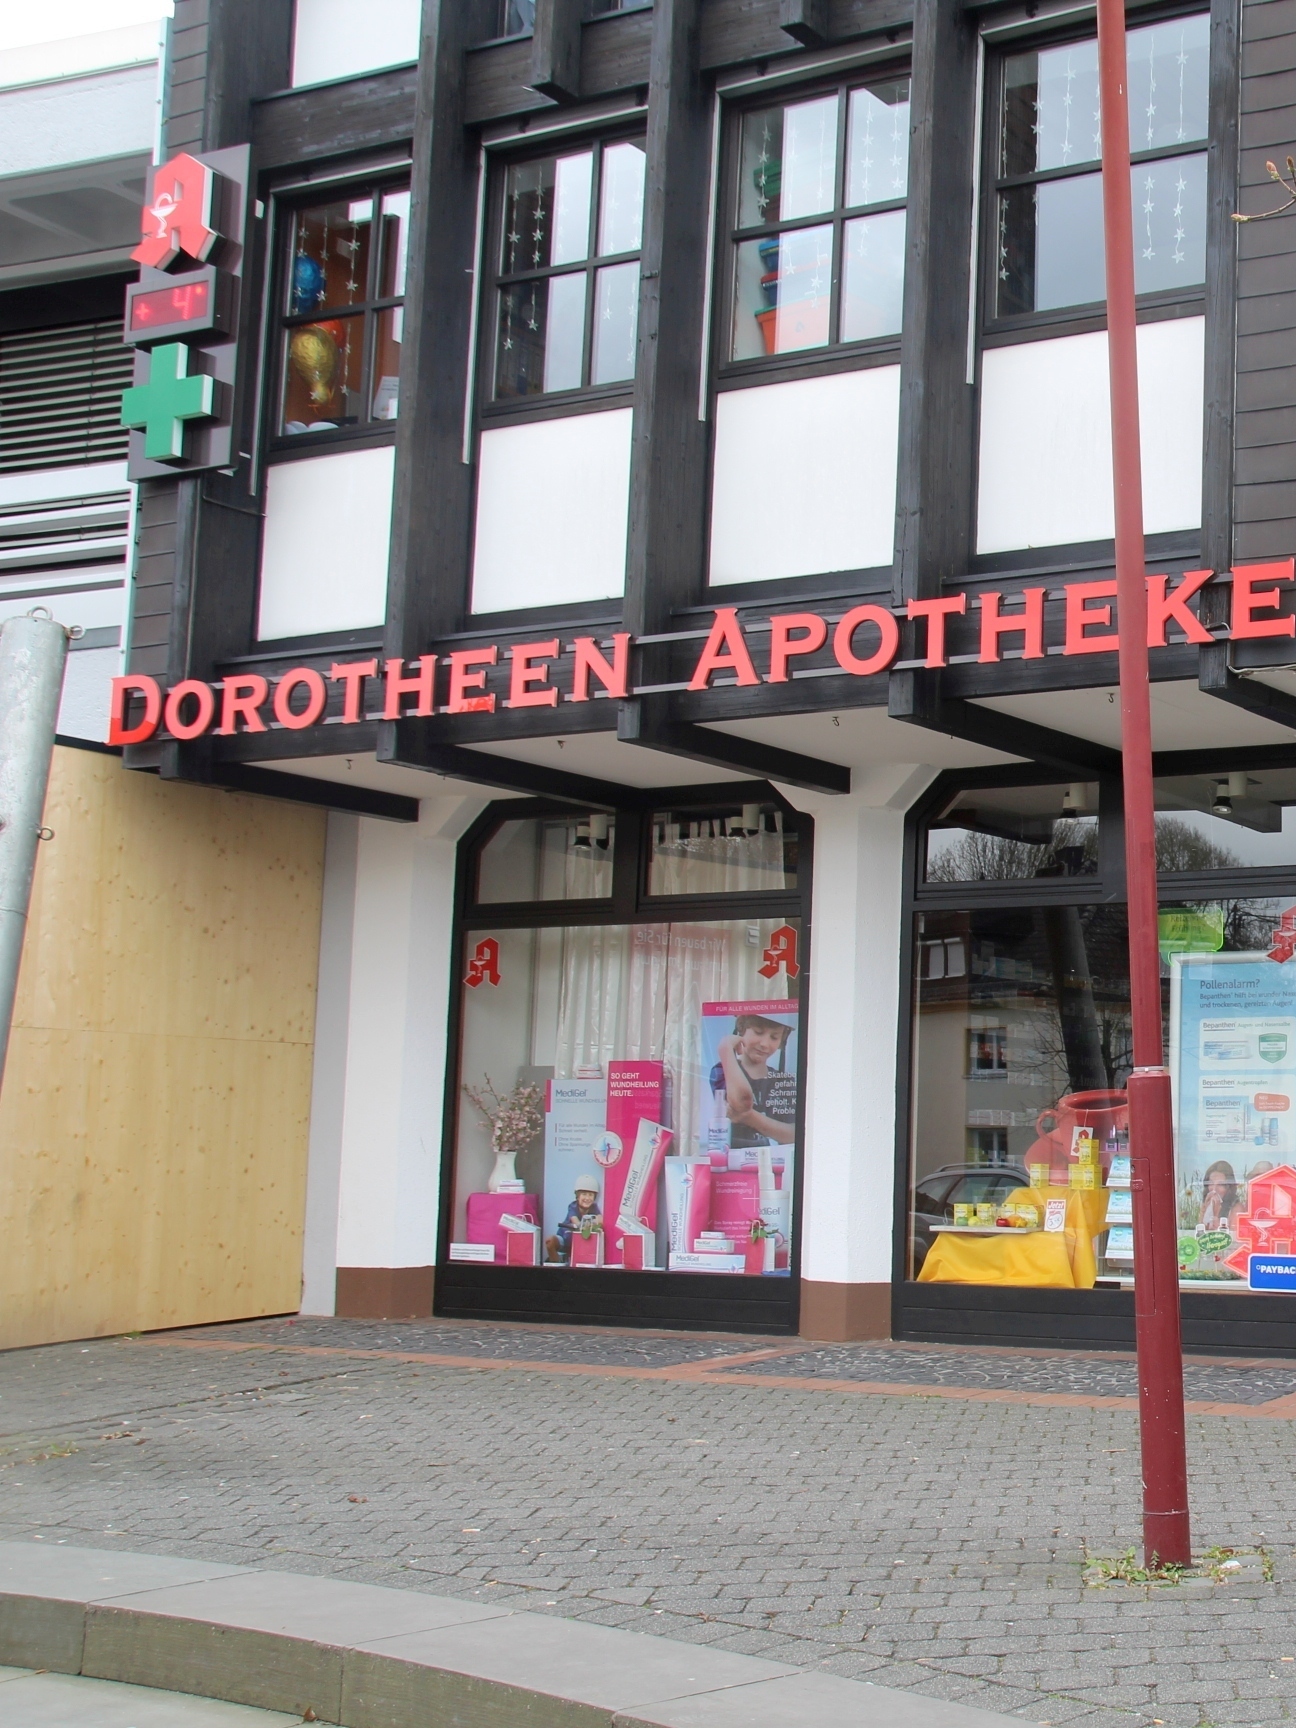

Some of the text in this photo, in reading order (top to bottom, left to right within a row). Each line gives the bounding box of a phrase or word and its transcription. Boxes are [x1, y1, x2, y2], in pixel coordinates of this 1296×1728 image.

[103, 556, 1296, 746] DOROTHEEN APOTHEKE
[1200, 979, 1260, 989] Pollenalarm?
[610, 1072, 640, 1080] SO GEHT
[556, 1089, 587, 1097] MediGel
[622, 1170, 640, 1207] MediGel
[671, 1212, 679, 1251] MediGel
